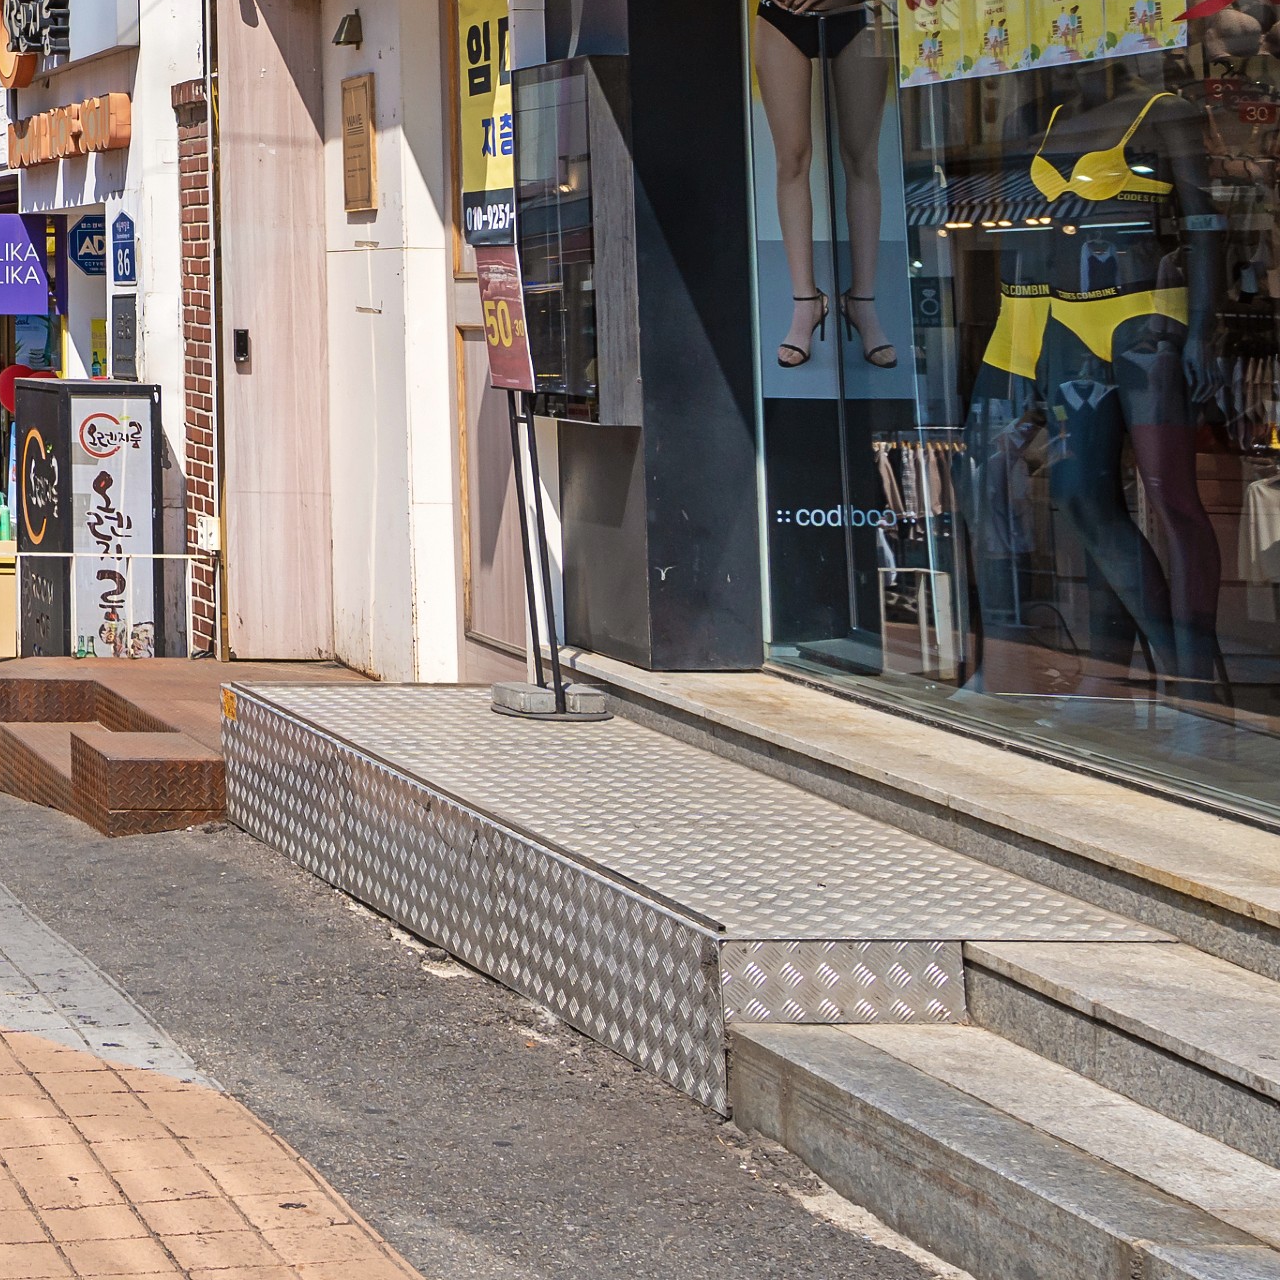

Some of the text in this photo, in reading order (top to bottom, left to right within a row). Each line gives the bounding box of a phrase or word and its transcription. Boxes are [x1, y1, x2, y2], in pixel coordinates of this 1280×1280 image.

[1245, 106, 1269, 122] 30
[117, 248, 130, 276] 86
[1077, 286, 1117, 300] COMBINE
[89, 422, 143, 449] 오렌지룸
[87, 471, 132, 621] 오렌지룸
